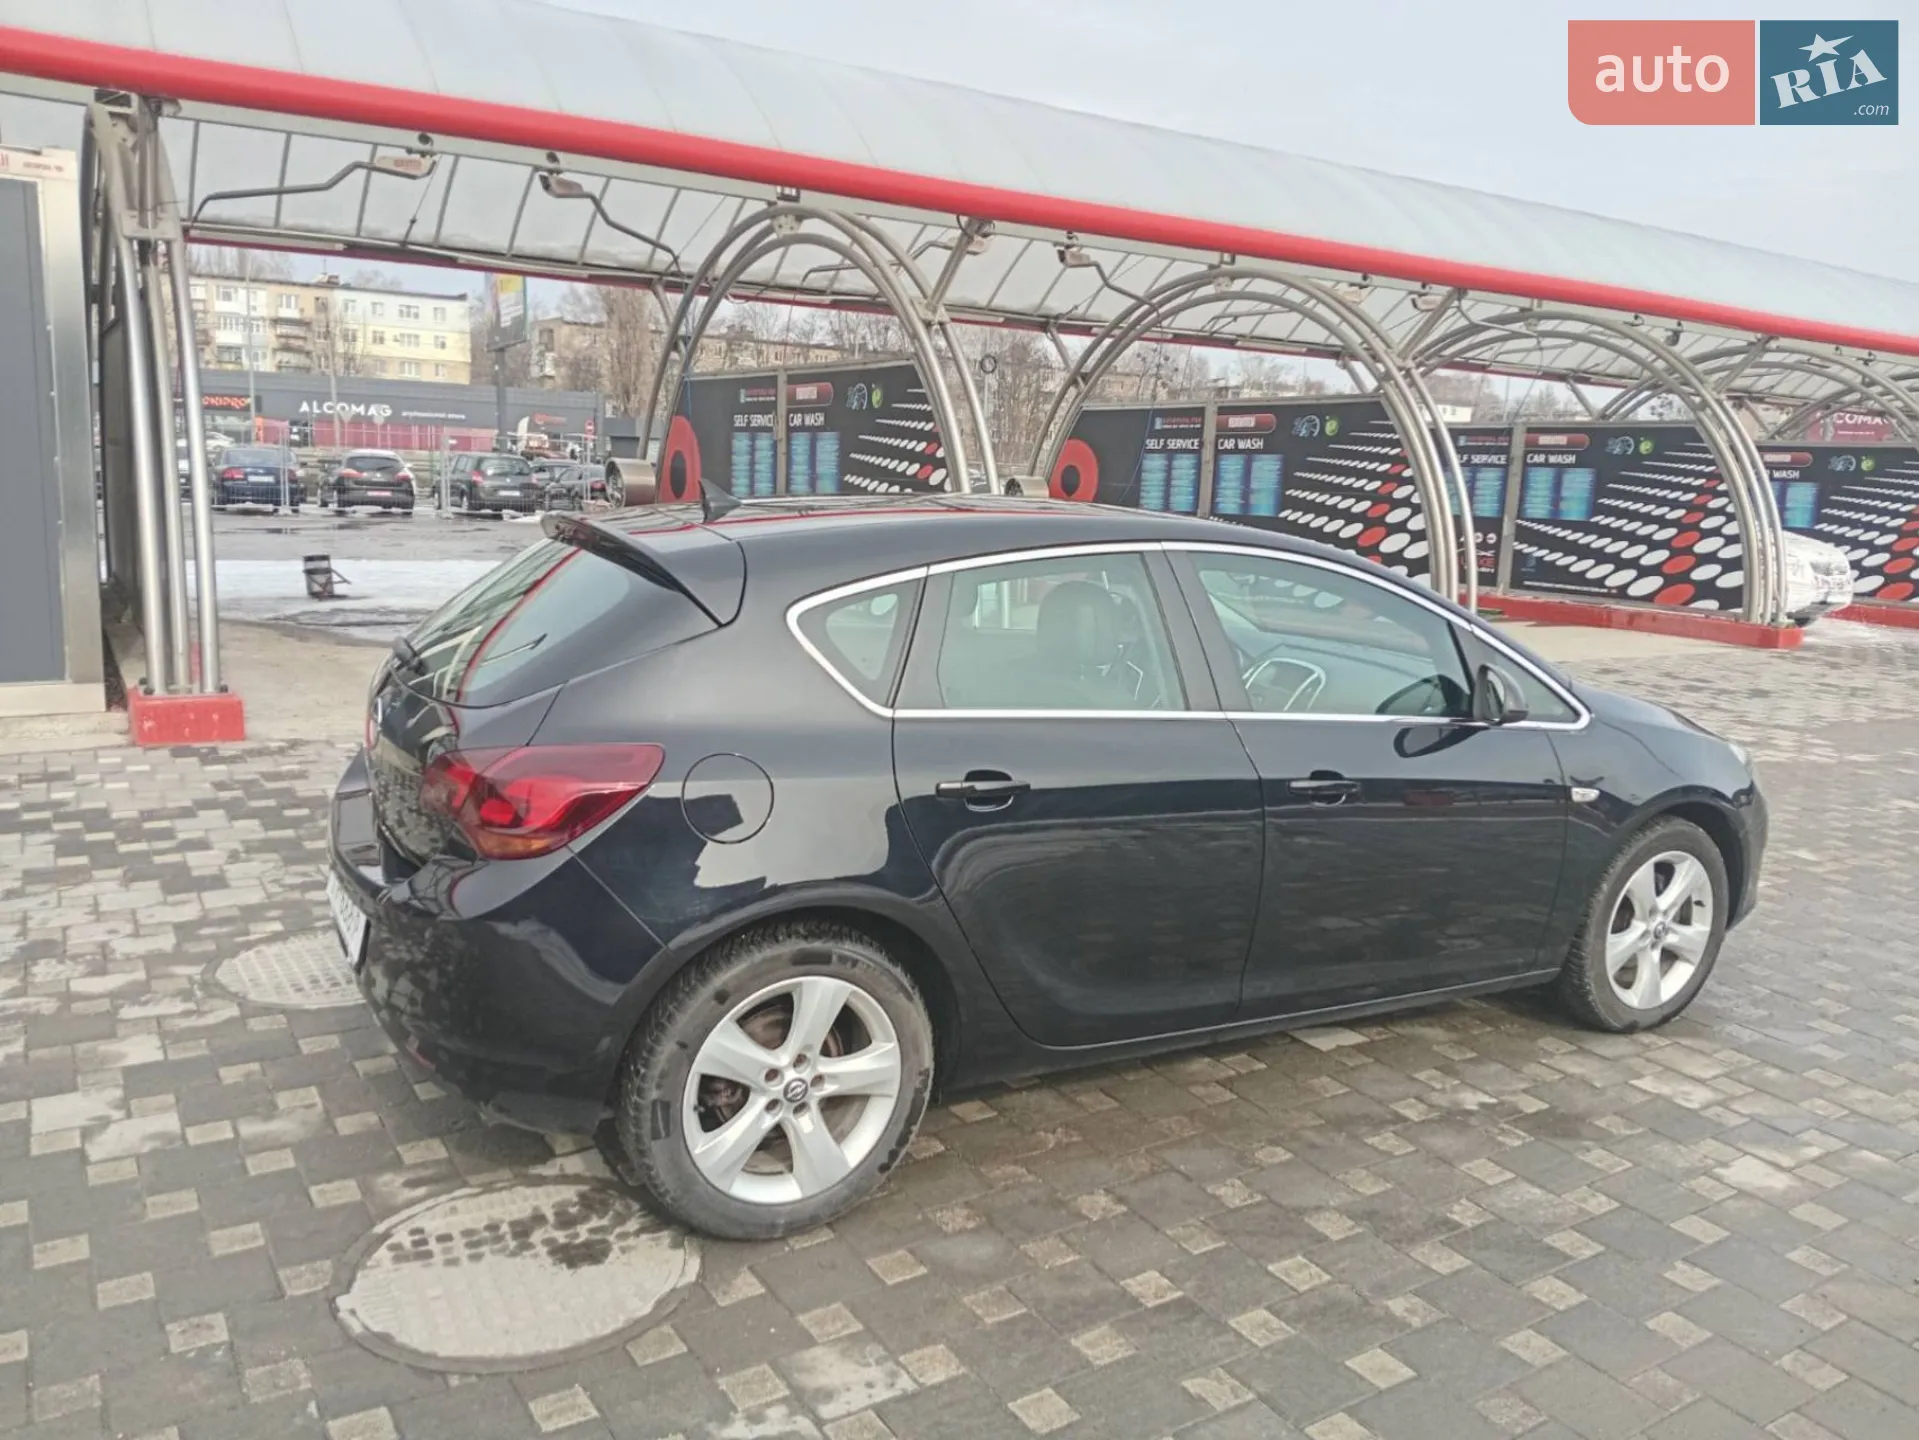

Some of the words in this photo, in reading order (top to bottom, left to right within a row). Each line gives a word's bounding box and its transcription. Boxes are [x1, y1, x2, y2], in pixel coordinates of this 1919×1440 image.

[298, 399, 393, 417] ALCOMAG
[733, 414, 749, 427] SELF
[789, 413, 802, 427] CAR
[803, 412, 825, 427] WASH
[1145, 439, 1163, 450] SELF
[1166, 438, 1199, 450] SERVICE
[1218, 439, 1235, 450] CAR
[1237, 438, 1264, 450] WASH
[1470, 454, 1507, 464] SERVICE
[1526, 453, 1546, 464] CAR
[1547, 453, 1576, 465] WASH
[1772, 470, 1800, 480] WASH
